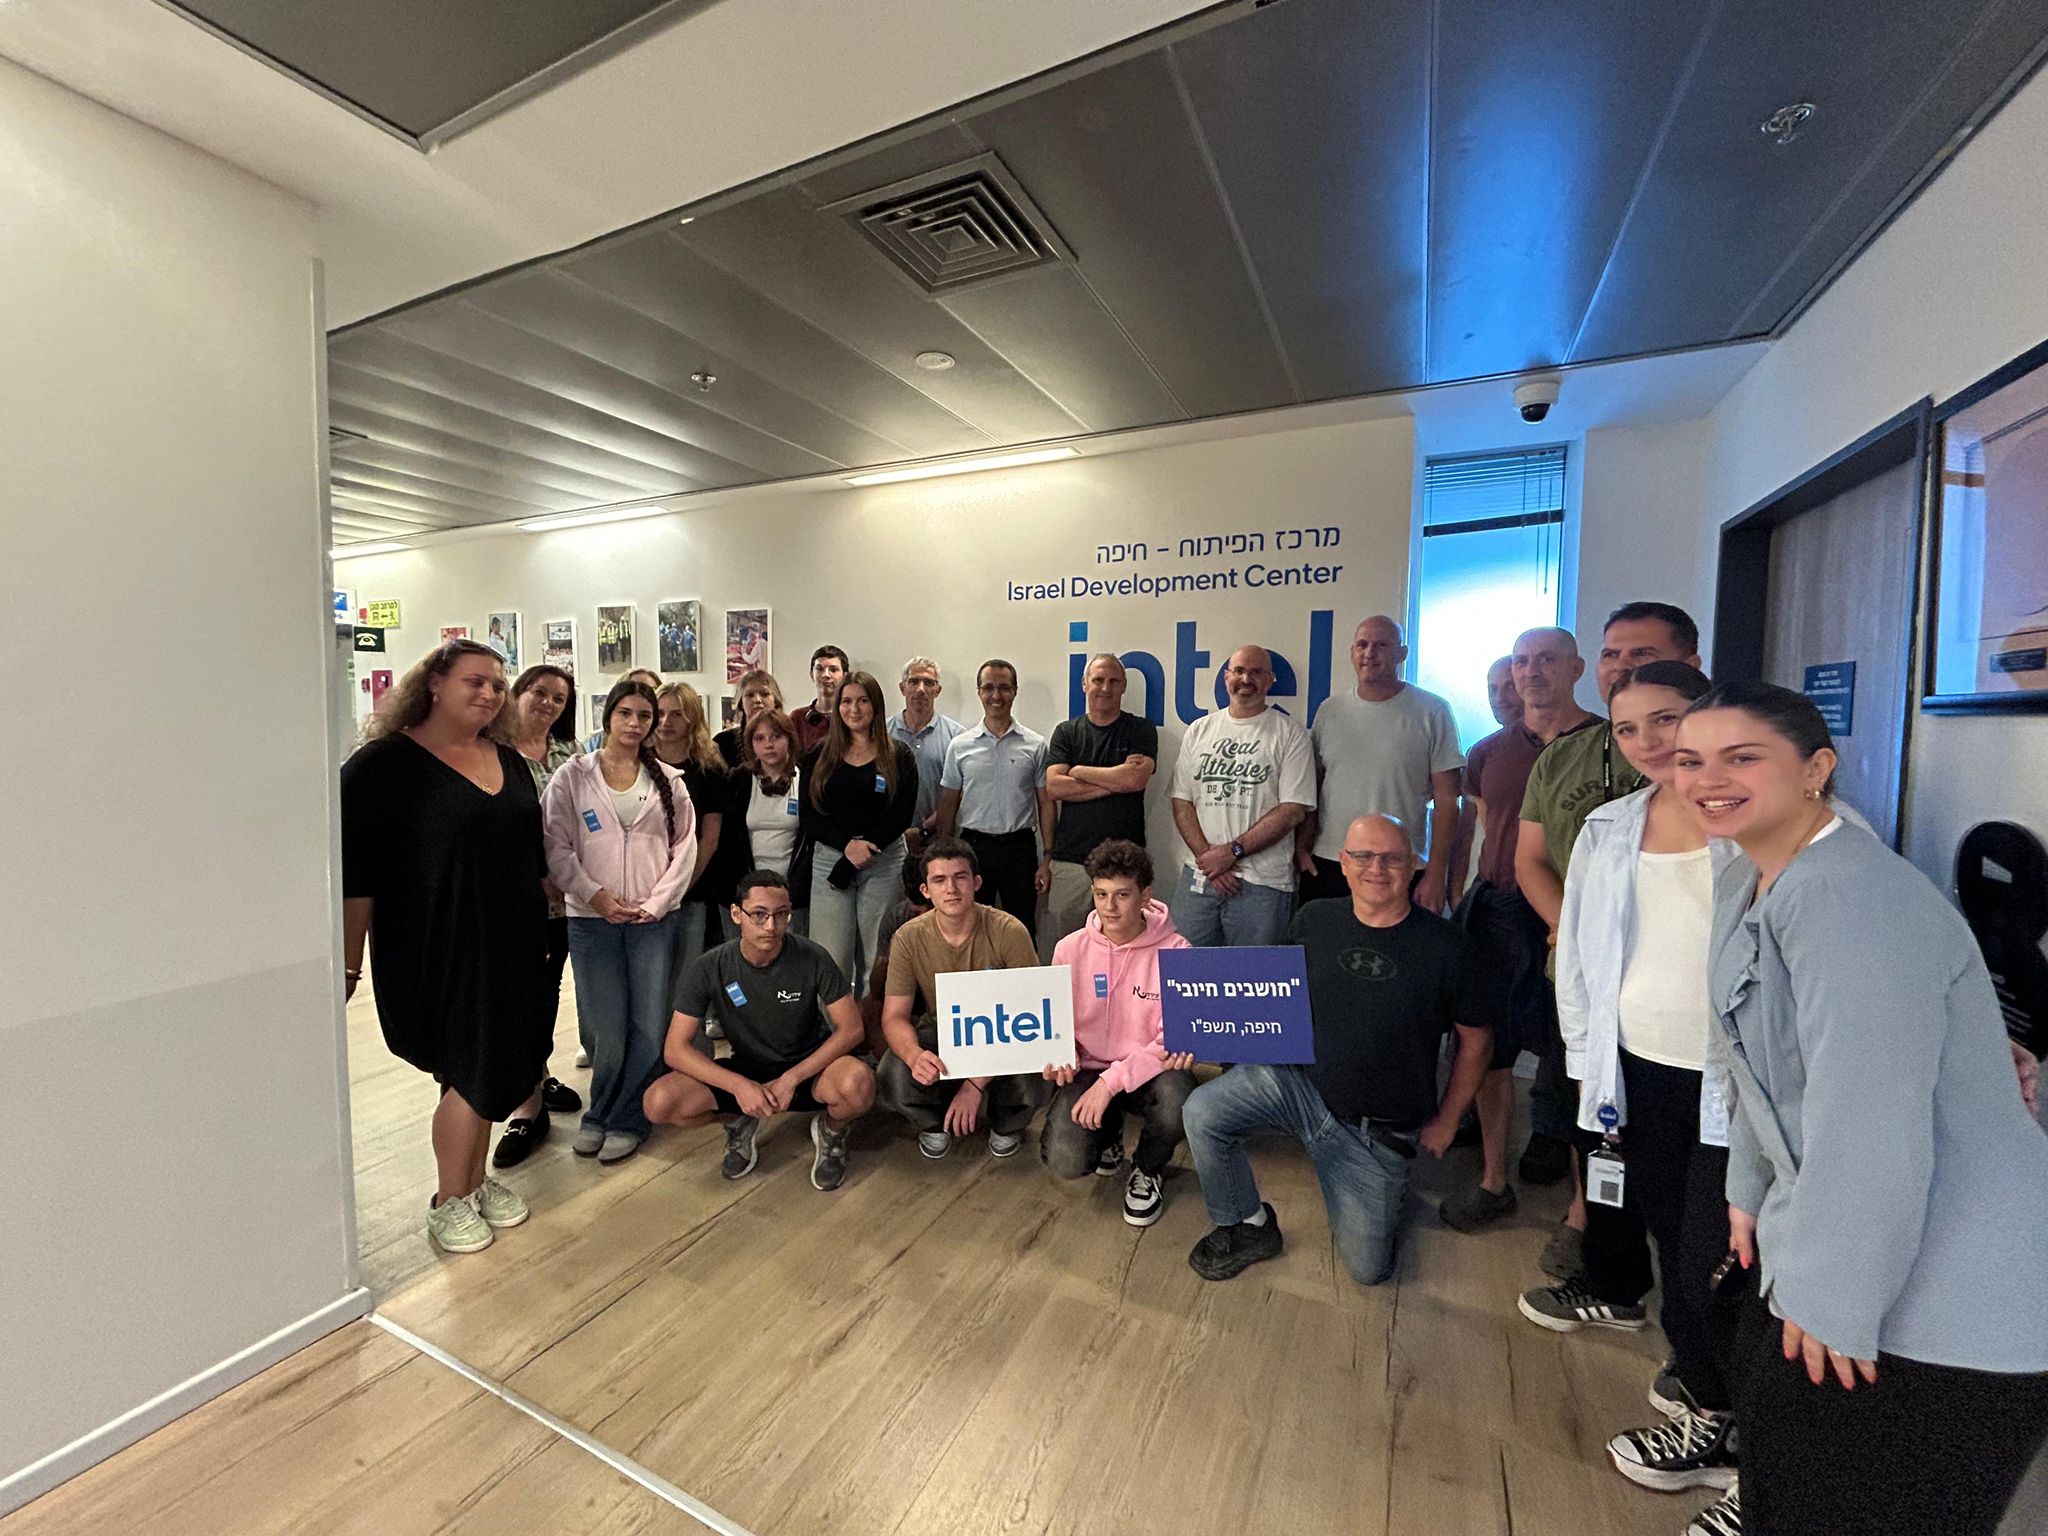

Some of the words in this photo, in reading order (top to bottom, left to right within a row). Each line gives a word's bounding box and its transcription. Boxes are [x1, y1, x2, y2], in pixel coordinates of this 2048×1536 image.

[1179, 532, 1264, 558] הפיתוח
[1276, 527, 1340, 550] מרכז
[1097, 543, 1147, 564] חיפה
[1007, 578, 1065, 601] Israel
[1071, 568, 1238, 598] Development
[1244, 563, 1344, 588] Center
[1212, 738, 1260, 758] Real
[1194, 753, 1275, 783] Athletes
[1241, 1021, 1282, 1036] חיפה,
